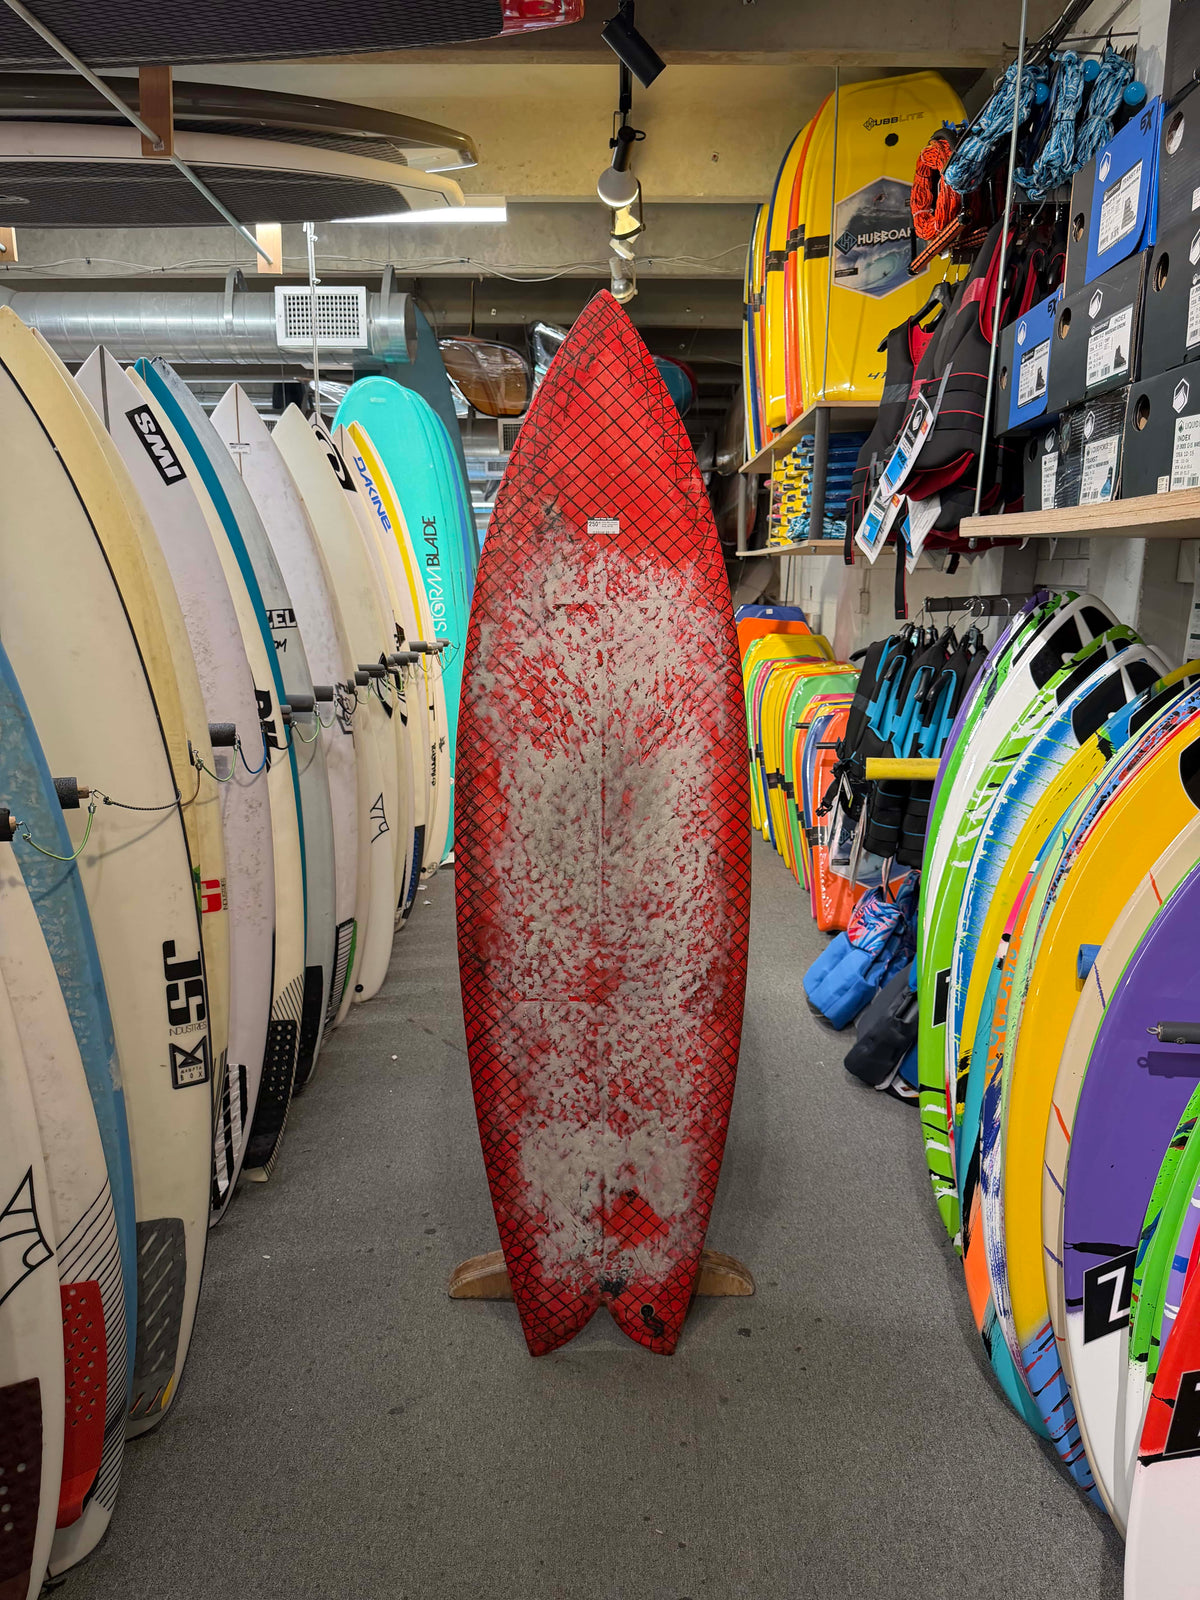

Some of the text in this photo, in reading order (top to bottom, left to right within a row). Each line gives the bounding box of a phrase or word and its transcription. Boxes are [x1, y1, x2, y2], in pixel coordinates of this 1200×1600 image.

[134, 412, 182, 478] SMI
[353, 456, 392, 533] DAKINE
[169, 1021, 207, 1037] INDUSTRIES
[180, 1070, 203, 1082] BOX
